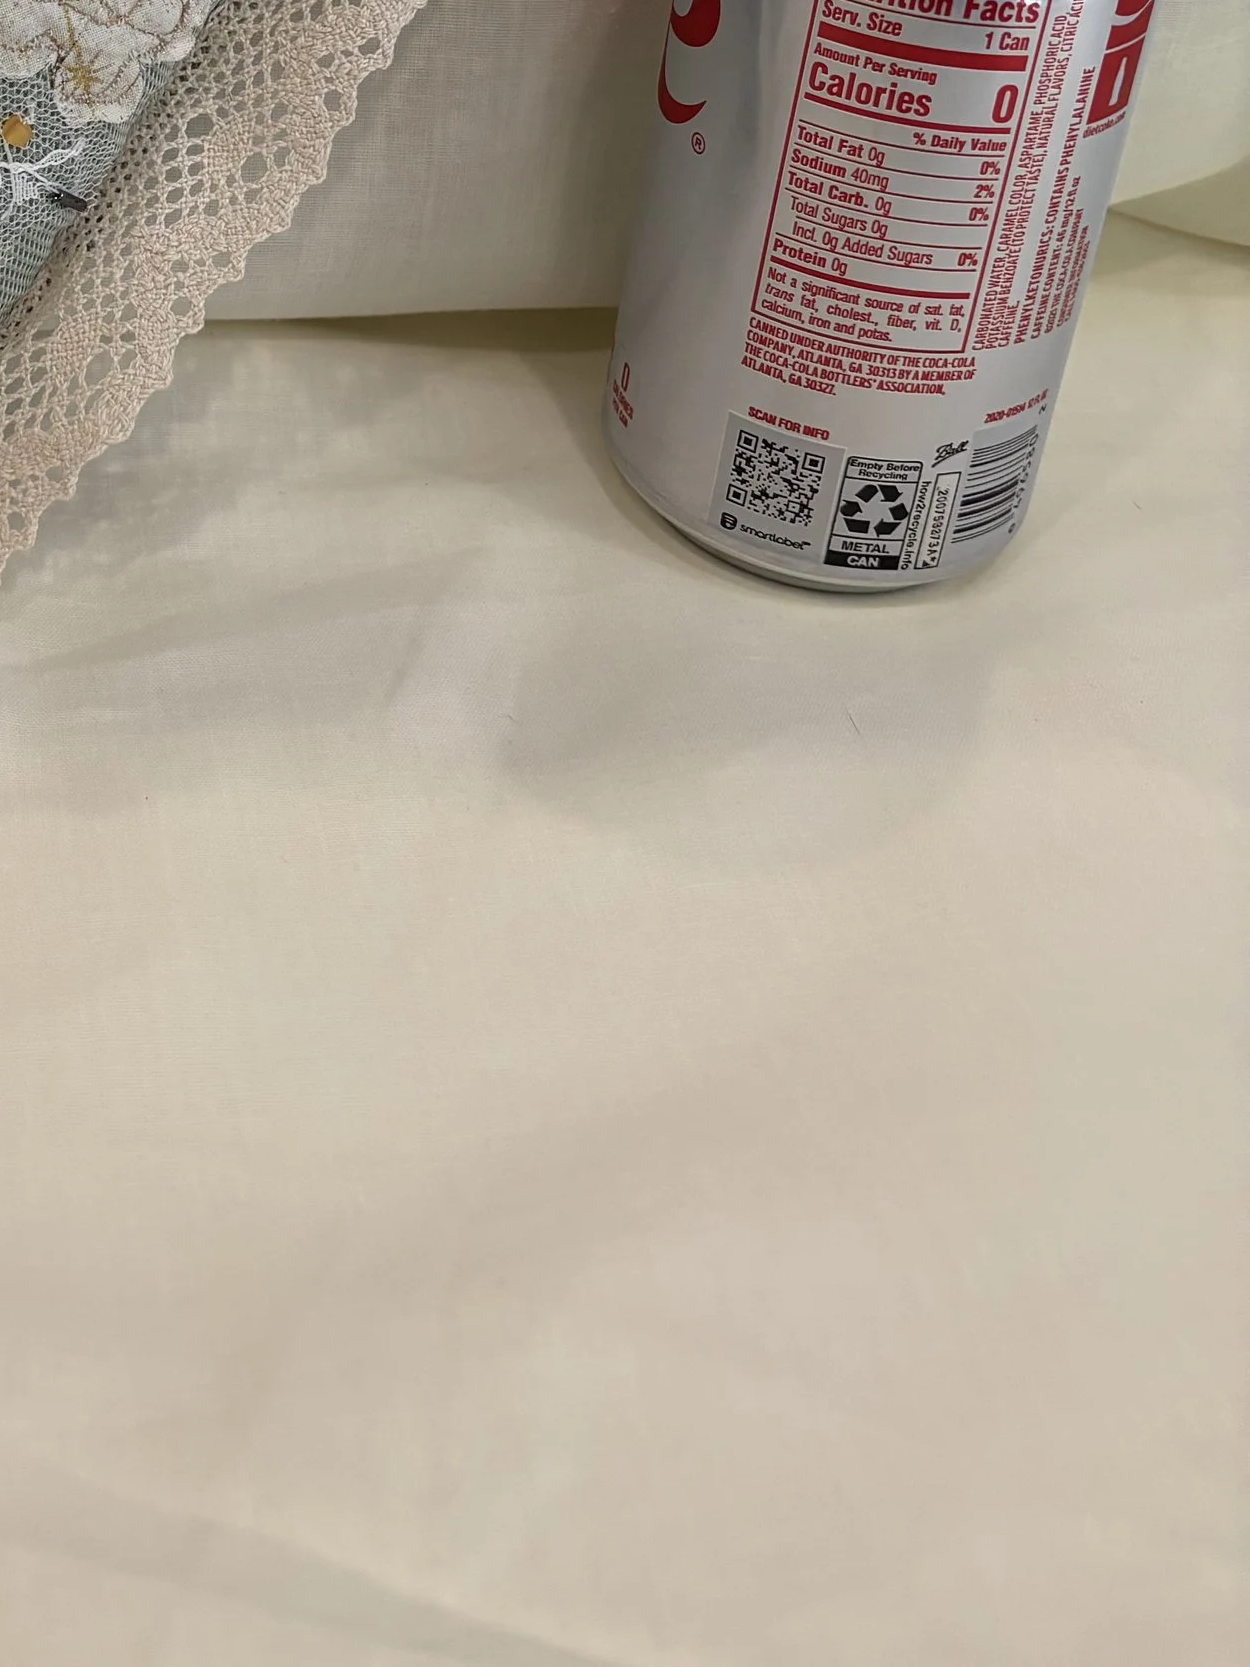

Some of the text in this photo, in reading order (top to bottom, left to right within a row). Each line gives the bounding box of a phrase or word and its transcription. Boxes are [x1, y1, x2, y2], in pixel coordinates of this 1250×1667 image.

[822, 0, 903, 36] Serv. Size
[1060, 20, 1079, 52] CITRIC
[984, 31, 1031, 51] 1 Can
[814, 42, 938, 86] Amount Per Serving
[1048, 53, 1072, 104] FLAVORS,
[808, 61, 1019, 124] Calories 0
[797, 125, 886, 167] Total Fat 0g
[931, 134, 966, 153] Daily
[970, 137, 1008, 152] Value
[1036, 104, 1059, 150] NATURAL
[791, 149, 890, 192] Sodium 40mg
[979, 160, 1001, 176] 0%
[787, 170, 892, 216] Total Carb. 0g
[972, 290, 999, 351] CARBONATED
[996, 208, 1020, 252] CARAMEL
[1033, 39, 1061, 105] PHOSPHORIC
[973, 184, 995, 199] 2%
[1014, 66, 1096, 344] PHENYLKETONURICS: CONTAINS PHENYLALANINE
[1016, 189, 1037, 230] PROTECT
[790, 195, 888, 239] Total Sugars 0g
[968, 207, 990, 222] 0%
[772, 237, 848, 277] Protein 0g
[792, 221, 933, 268] Incl. 0g Added Sugars
[957, 252, 978, 267] 0%
[1012, 230, 1027, 249] (TO
[768, 266, 966, 319] Not a significant source of sat. fat,
[999, 248, 1022, 298] BENZOATE
[1030, 292, 1051, 339] CAFFEINE
[1042, 244, 1063, 292] CONTENT:
[761, 298, 893, 343] calcium, iron and potas.
[765, 283, 962, 333] trans fat, cholest., fiber, vit. D,
[984, 297, 1008, 350] POTASSIUM
[997, 300, 1020, 348] CAFFEINE.
[746, 329, 978, 382] COMPANY, ATLANTA, GA 30313 BY A MEMBER OF
[749, 316, 976, 368] CANNED UNDER AUTHORITY OF THE COCA-COLA
[741, 355, 838, 397] ATLANTA, GA 30327.
[744, 341, 764, 359] THE
[763, 350, 822, 379] COCA-COLA
[876, 378, 947, 396] ASSOCIATION,
[747, 406, 830, 441] SCAN FOR INFO
[850, 458, 920, 472] Empty Before
[858, 468, 909, 481] Recycling
[840, 540, 890, 554] METAL
[900, 480, 933, 570] how2recycle.info
[846, 554, 881, 568] CAN
